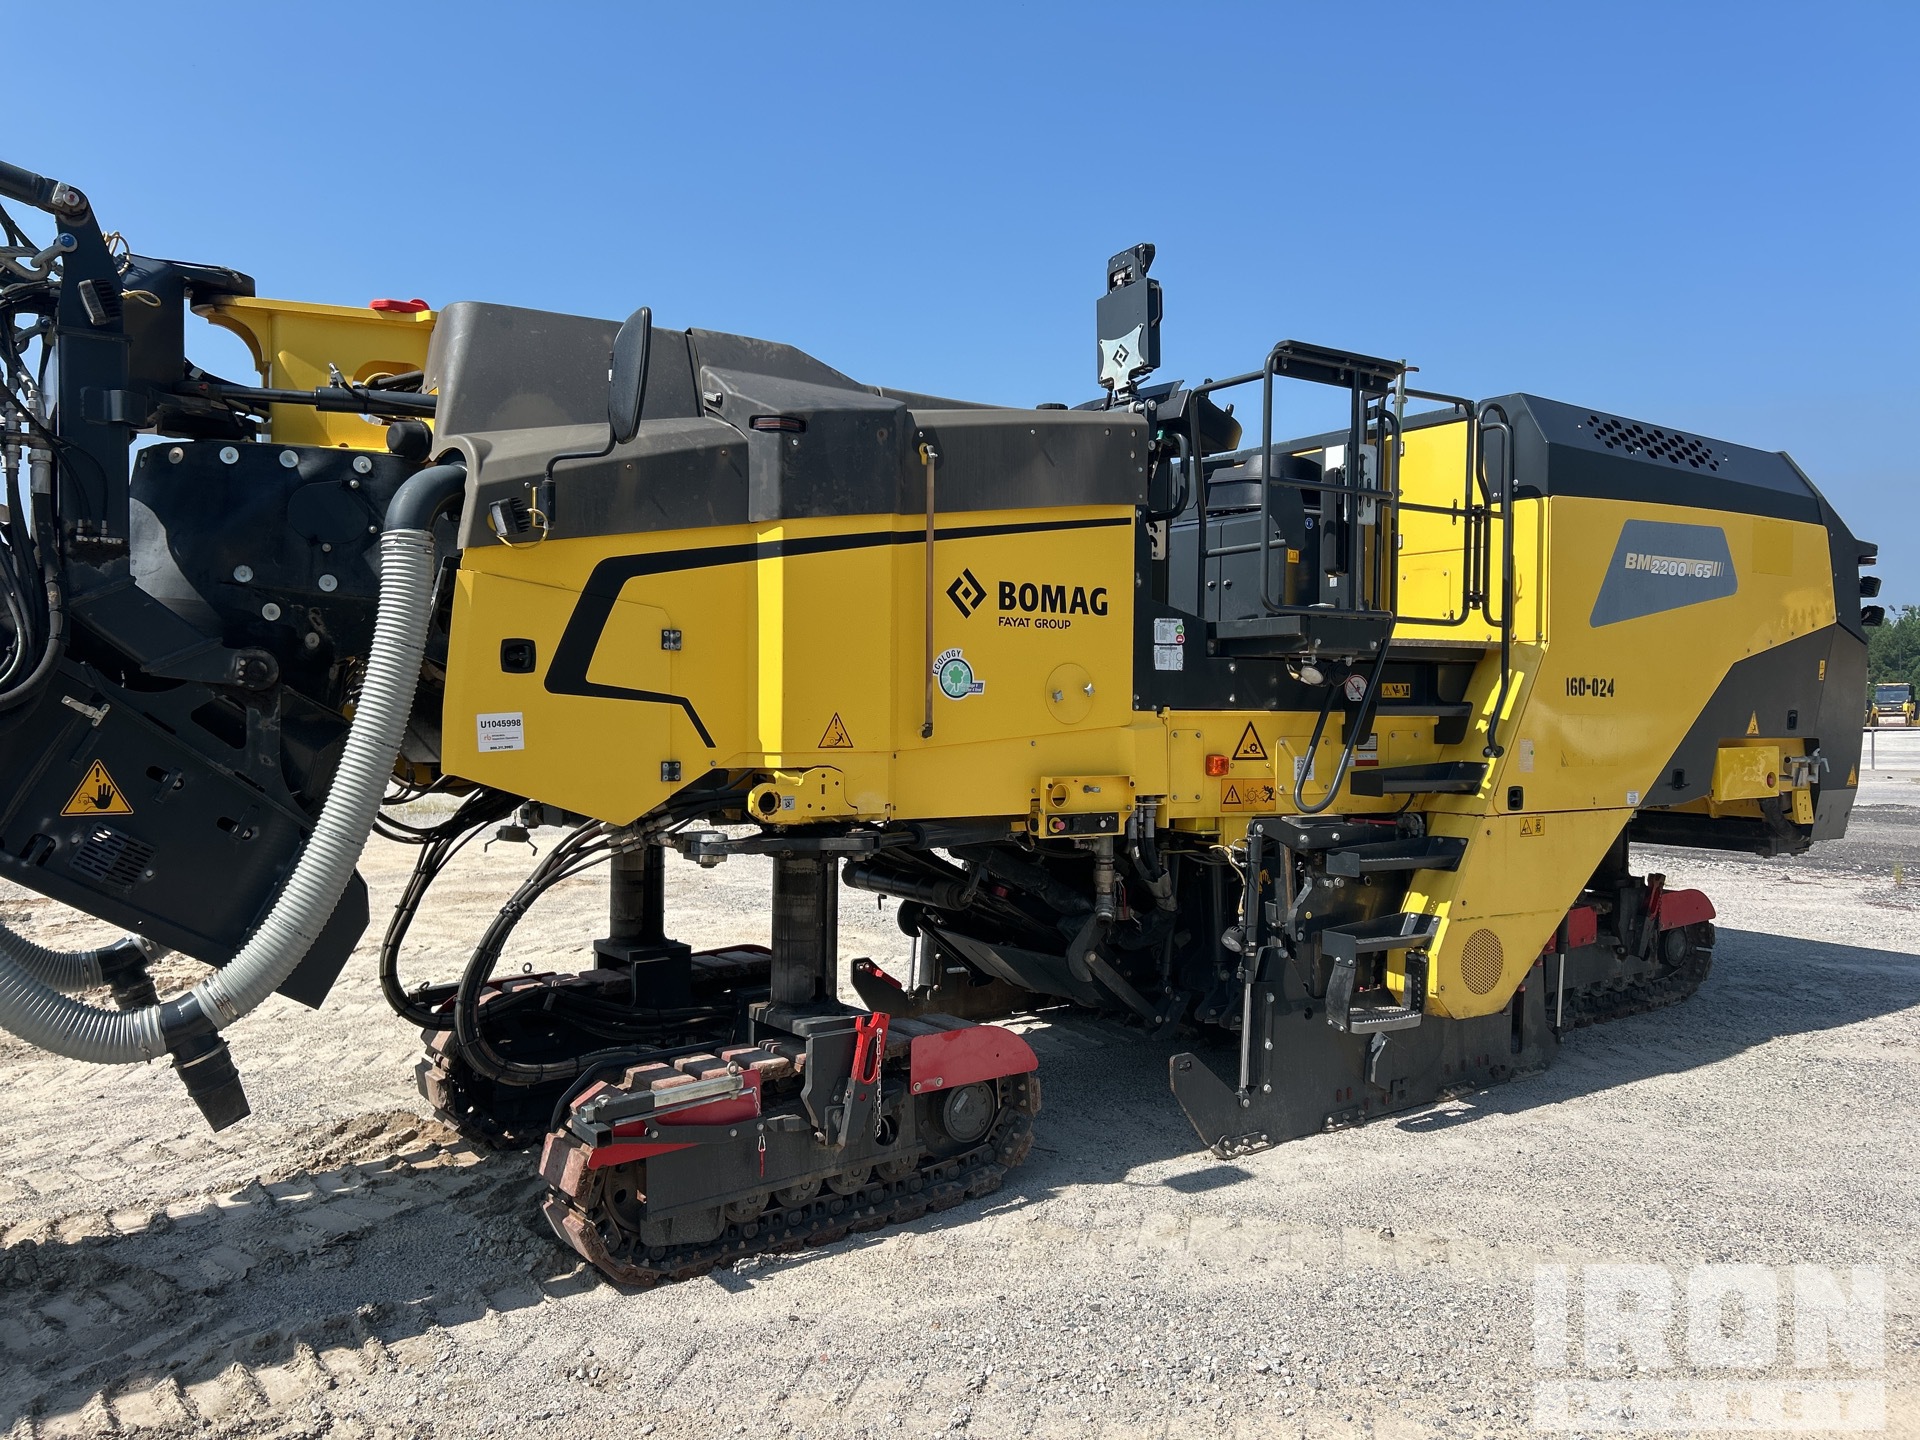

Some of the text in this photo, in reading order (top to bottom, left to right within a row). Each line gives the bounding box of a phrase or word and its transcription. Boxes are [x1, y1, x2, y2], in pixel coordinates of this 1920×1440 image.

[998, 581, 1107, 616] BOMAG
[998, 616, 1071, 629] FAYAT GROUP
[933, 649, 961, 675] ECOLOGY
[480, 719, 521, 729] U1045998
